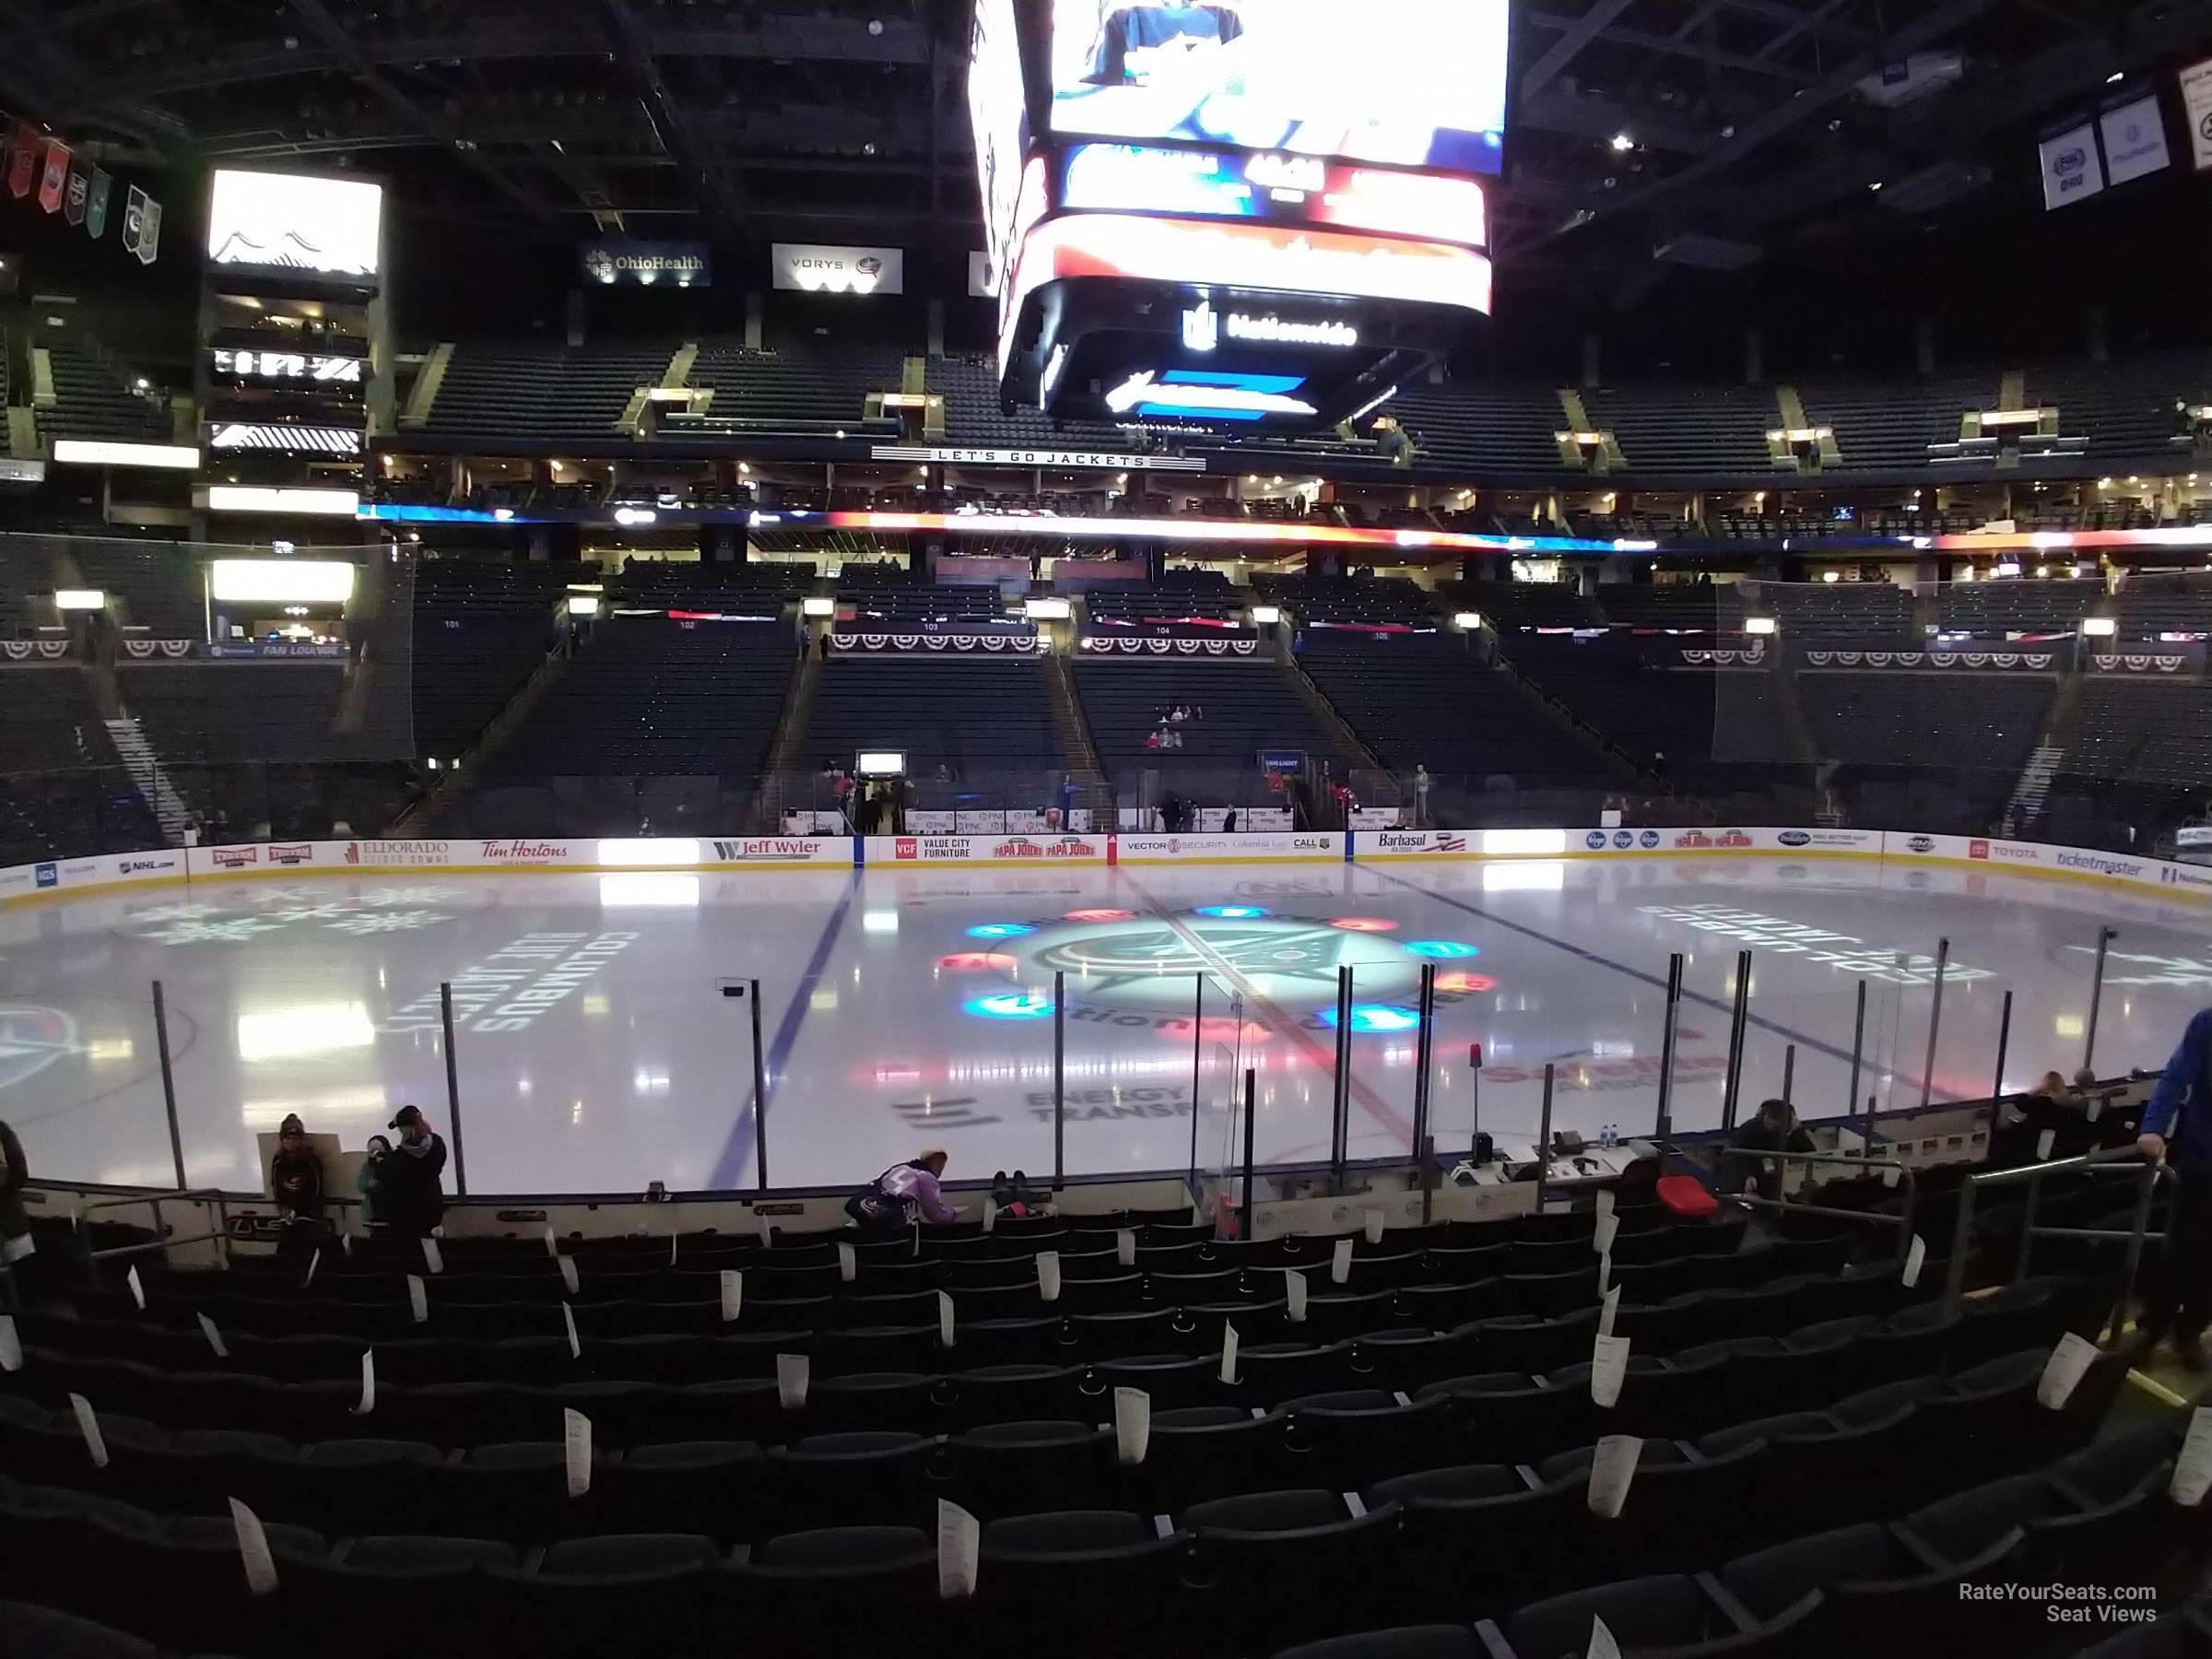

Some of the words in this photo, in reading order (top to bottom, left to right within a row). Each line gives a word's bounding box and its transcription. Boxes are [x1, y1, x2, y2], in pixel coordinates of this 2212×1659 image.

[616, 255, 703, 272] OhioHealth
[790, 258, 844, 270] VORYS
[1227, 313, 1358, 347] Nationwide
[937, 450, 996, 463] LET'S
[1010, 452, 1035, 464] GO
[1046, 453, 1145, 467] JACKETS
[443, 620, 459, 629] 101
[679, 620, 695, 629] 102
[924, 622, 938, 630] 103
[1156, 626, 1171, 635] 104
[263, 645, 287, 657] FAN
[290, 645, 339, 657] LOUNGE
[924, 839, 949, 848] VALUE
[951, 839, 971, 848] CITY
[1293, 839, 1317, 847] CALL
[1379, 833, 1427, 847] Barbasol
[363, 841, 449, 853] ELDORADO
[480, 839, 512, 858] Tim
[510, 838, 568, 858] Hortons
[742, 840, 772, 854] Jeff
[774, 841, 821, 855] Wyler
[897, 843, 917, 854] VCF
[994, 844, 1015, 856] PAPA
[1047, 844, 1067, 856] PAPA
[1993, 846, 2039, 859] TOYOTA
[924, 849, 971, 858] FURNITURE
[2057, 852, 2145, 877] ticketmaster
[1025, 1087, 1187, 1106] ENERGY
